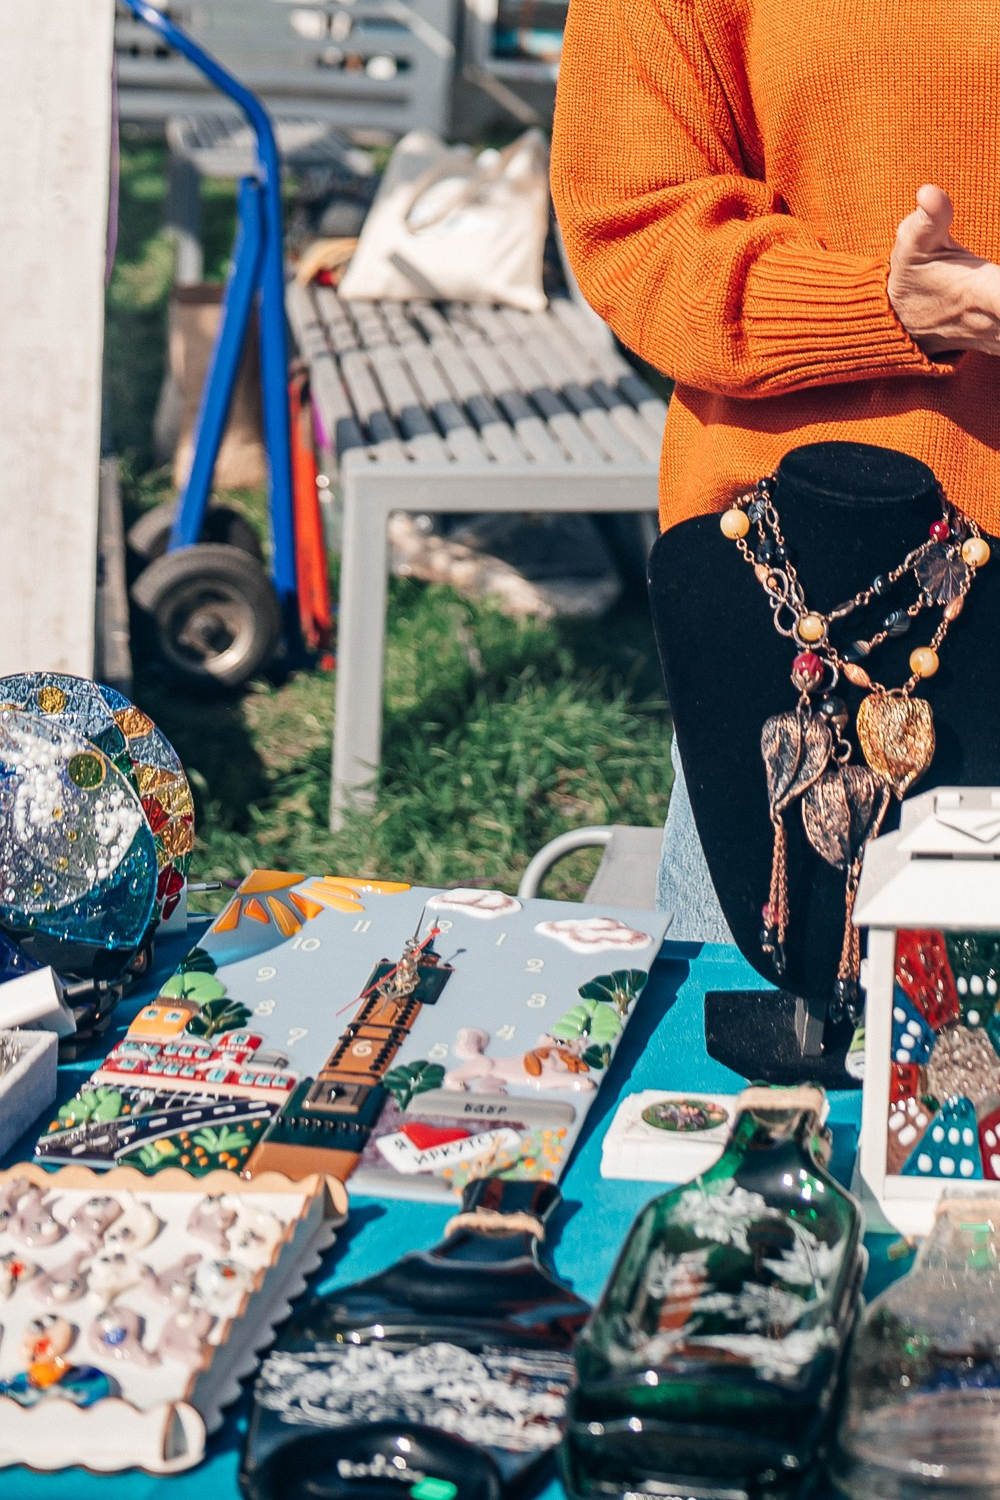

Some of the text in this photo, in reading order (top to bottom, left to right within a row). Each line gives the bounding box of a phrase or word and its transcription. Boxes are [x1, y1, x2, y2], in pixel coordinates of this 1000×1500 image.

[352, 919, 372, 933] 11
[425, 919, 453, 934] 12
[291, 937, 322, 952] 10
[496, 932, 506, 946] 1
[525, 958, 545, 973] 2
[255, 966, 277, 982] 9
[254, 999, 276, 1016] 8
[527, 992, 547, 1008] 3
[286, 1027, 309, 1046] 7
[496, 1024, 516, 1041] 4
[351, 1040, 373, 1057] 6
[428, 1043, 449, 1059] 5
[394, 1139, 408, 1150] Я
